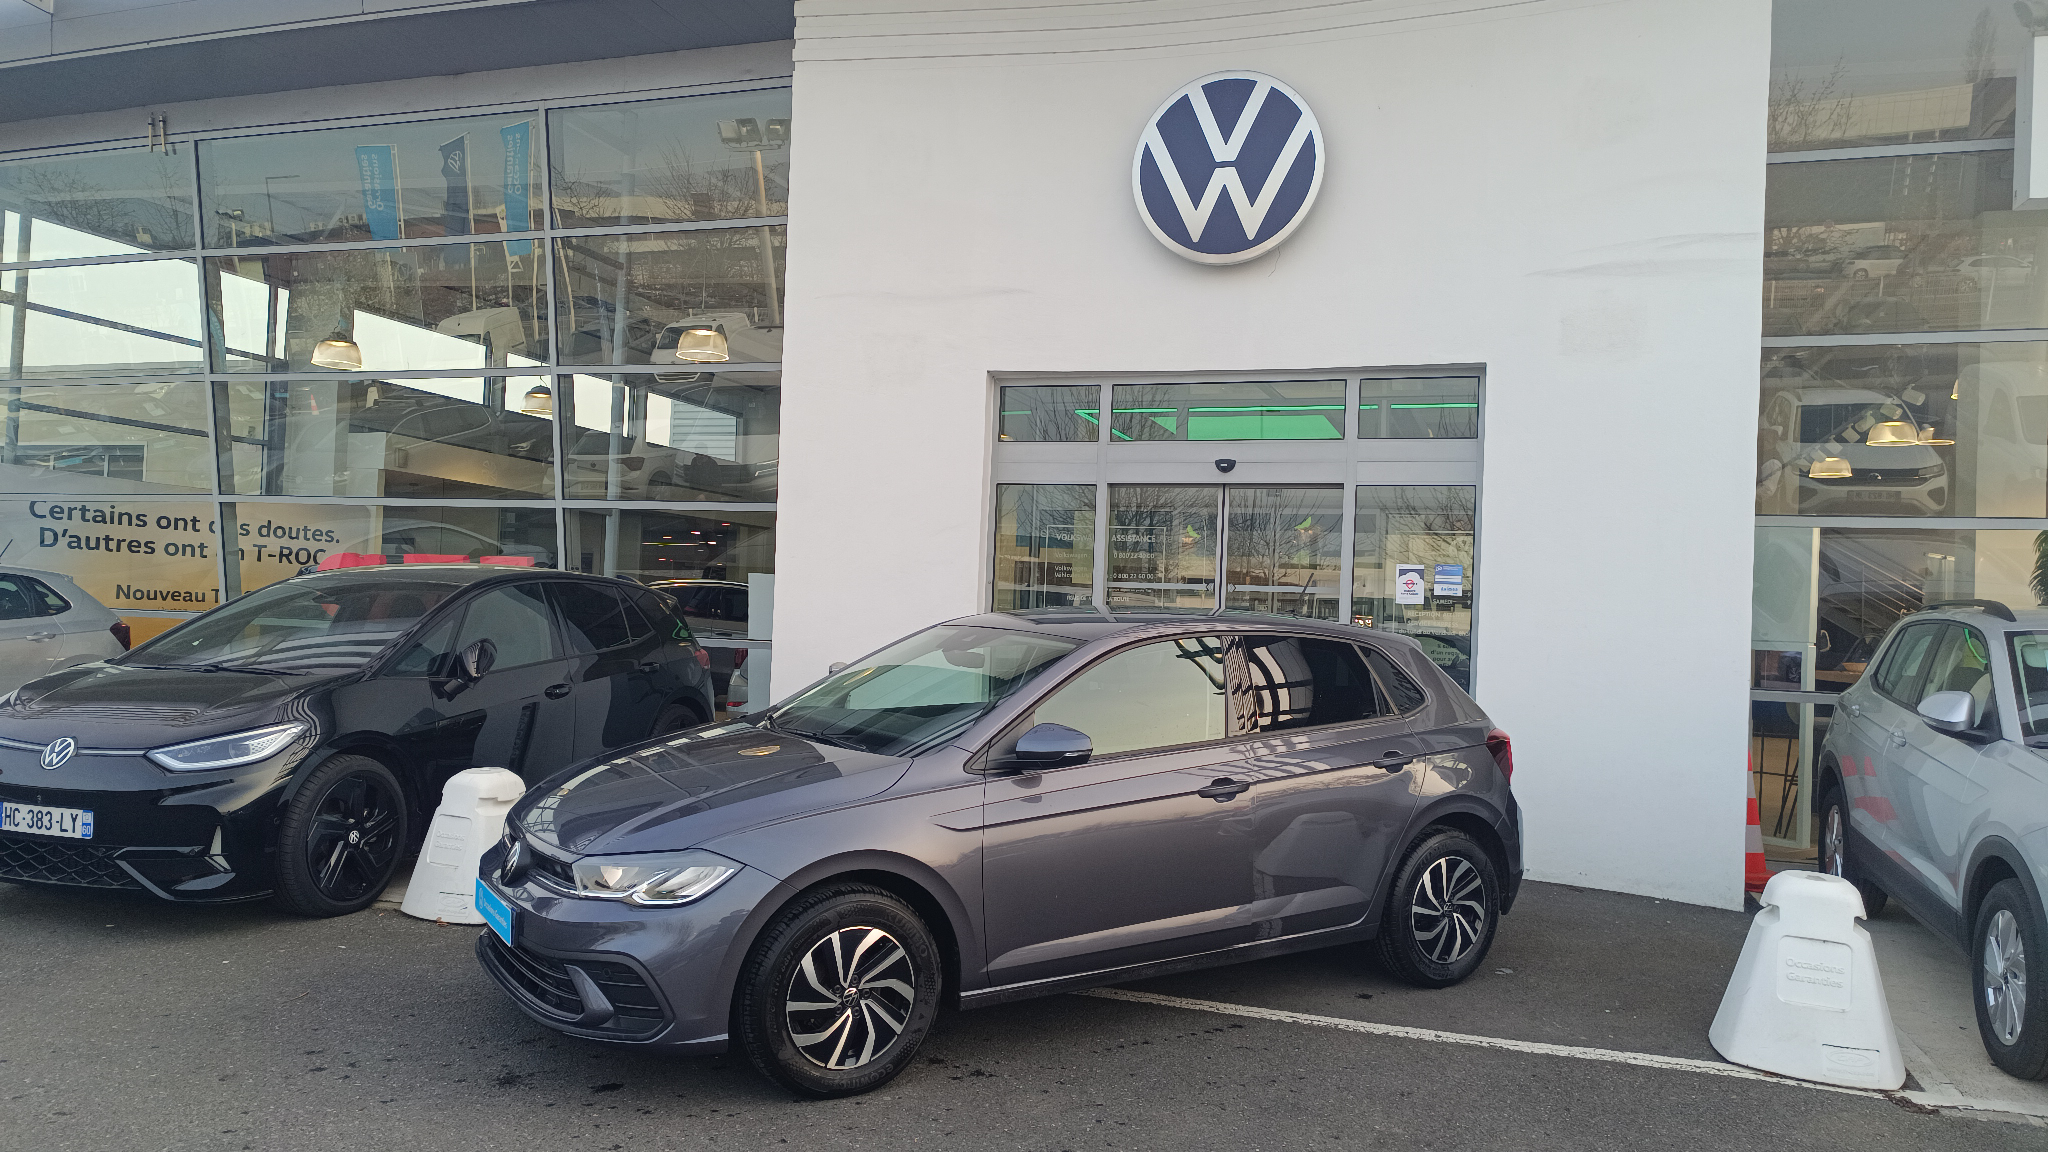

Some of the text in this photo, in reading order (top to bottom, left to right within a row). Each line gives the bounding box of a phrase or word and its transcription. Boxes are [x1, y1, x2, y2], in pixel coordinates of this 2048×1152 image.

[28, 500, 148, 529] Certains
[155, 511, 201, 533] ont
[257, 519, 340, 544] doutes.
[38, 526, 156, 555] D'autres
[163, 541, 209, 559] ont
[252, 543, 327, 566] T-ROC
[1055, 533, 1093, 542] VOLKSWA
[1111, 534, 1156, 543] ASSISTANCE
[115, 584, 206, 605] Nouveau
[4, 806, 79, 834] HC-383-LY
[82, 825, 91, 835] 60
[1785, 957, 1845, 975] Occasions
[1785, 972, 1844, 989] Garanties
